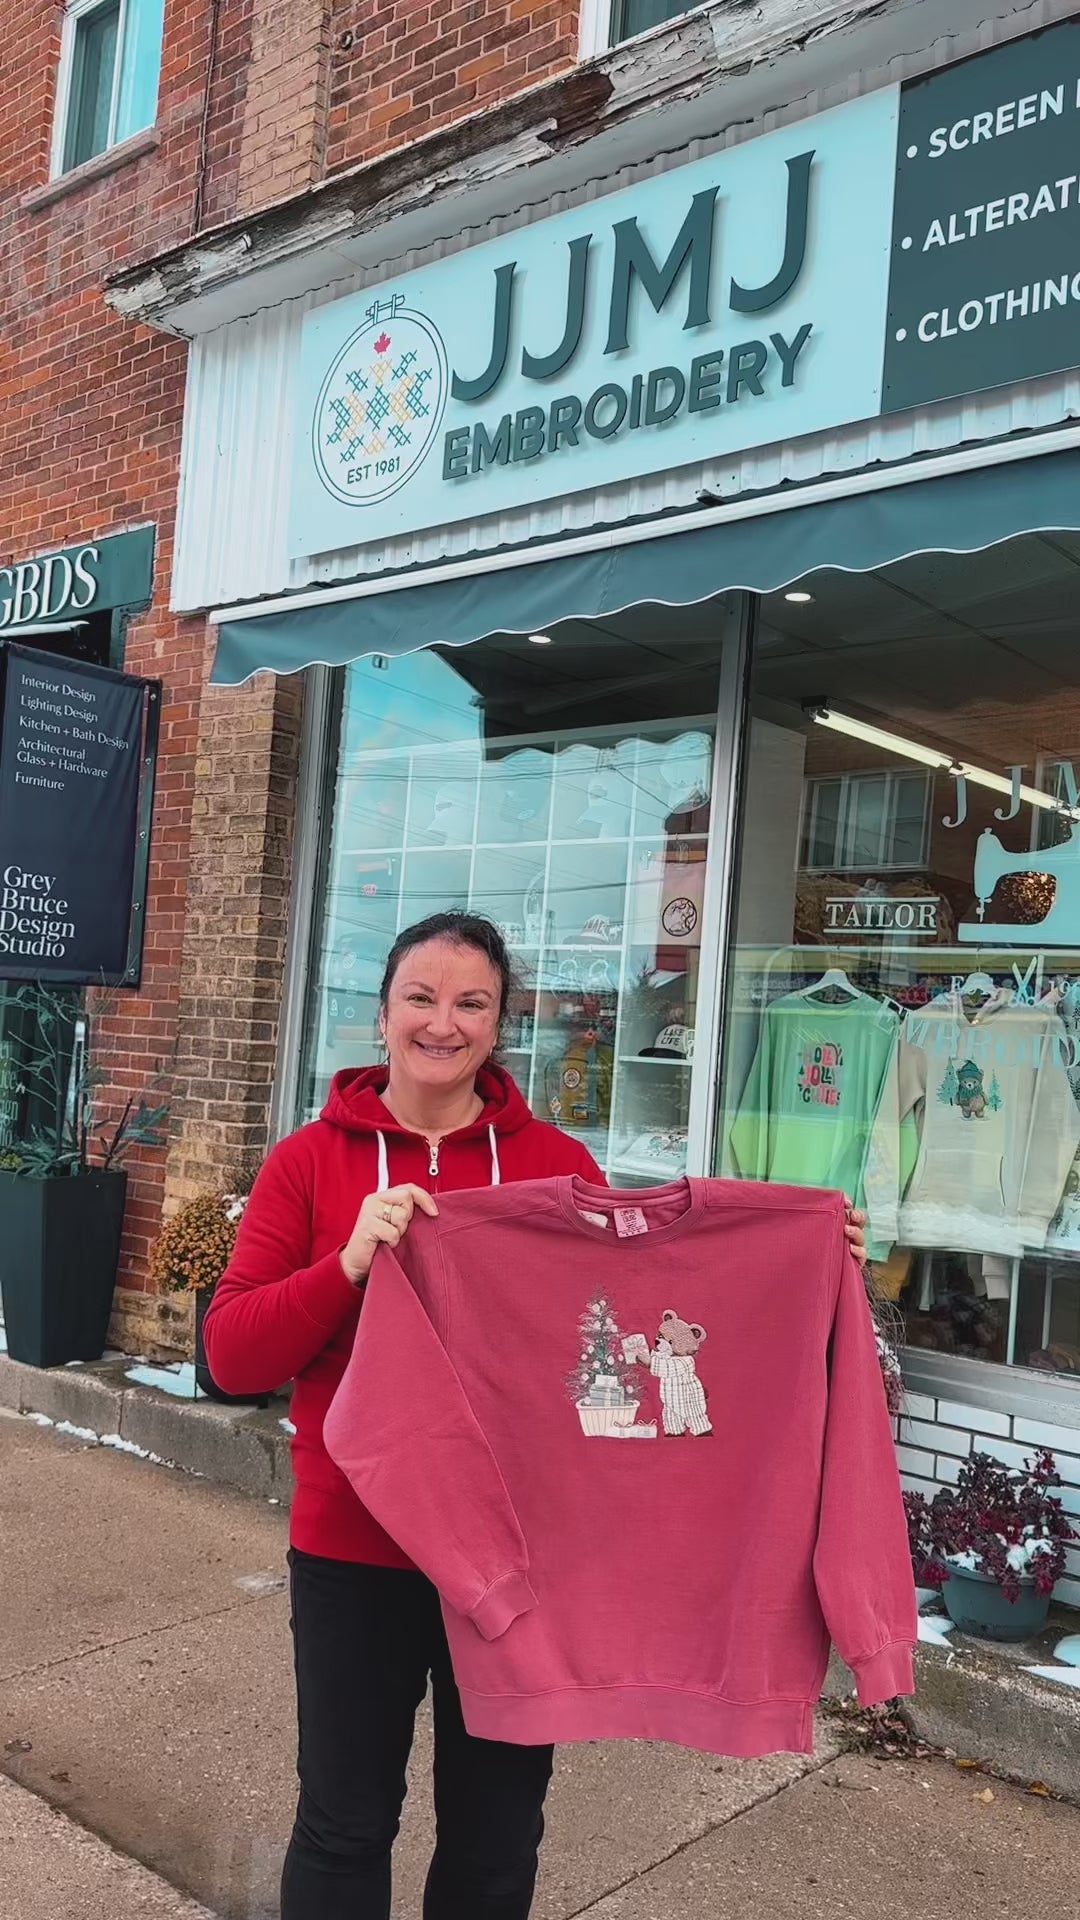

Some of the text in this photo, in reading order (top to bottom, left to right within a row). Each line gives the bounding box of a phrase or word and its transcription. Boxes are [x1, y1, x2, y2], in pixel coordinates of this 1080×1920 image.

[928, 84, 1064, 158] SCREEN
[922, 171, 1080, 252] ALTERAT
[451, 149, 816, 401] JJMJ
[441, 322, 814, 481] EMBROIDERY
[347, 456, 400, 484] EST 1981
[21, 674, 96, 703] Interior Design
[20, 695, 98, 723] Lighting Design
[20, 715, 129, 750] Kitchen + Bath Design
[18, 737, 86, 760] Architectural
[16, 751, 108, 778] Glass + Hardware
[15, 771, 65, 790] Furniture
[3, 866, 56, 896] Grey
[1, 888, 68, 915] Bruce
[0, 910, 75, 941] Design
[825, 904, 937, 928] TAILOR
[0, 933, 65, 958] Studio
